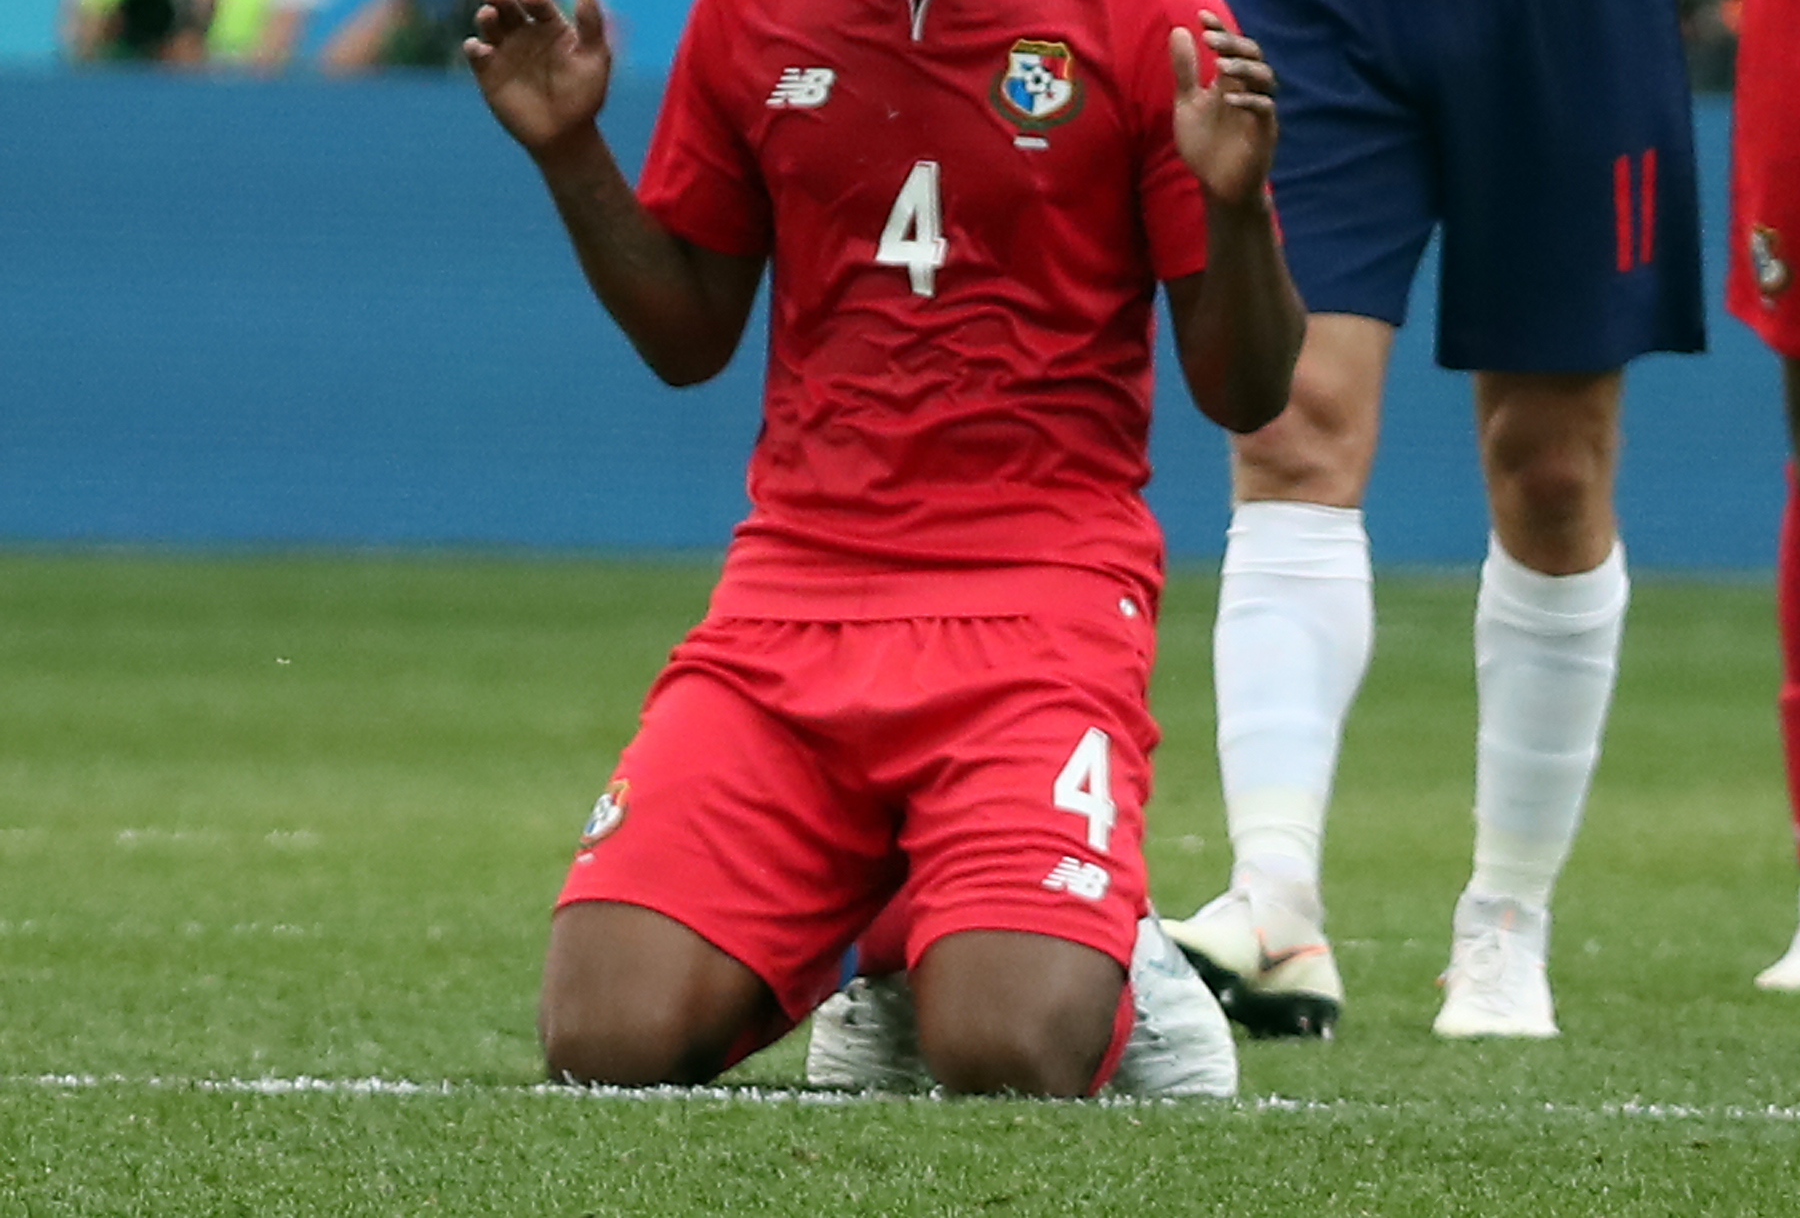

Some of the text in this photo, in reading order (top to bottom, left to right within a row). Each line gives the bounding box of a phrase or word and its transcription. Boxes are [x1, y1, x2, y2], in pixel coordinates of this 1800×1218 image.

[874, 160, 948, 299] 4
[1613, 147, 1658, 272] 11
[1053, 725, 1118, 853] 4
